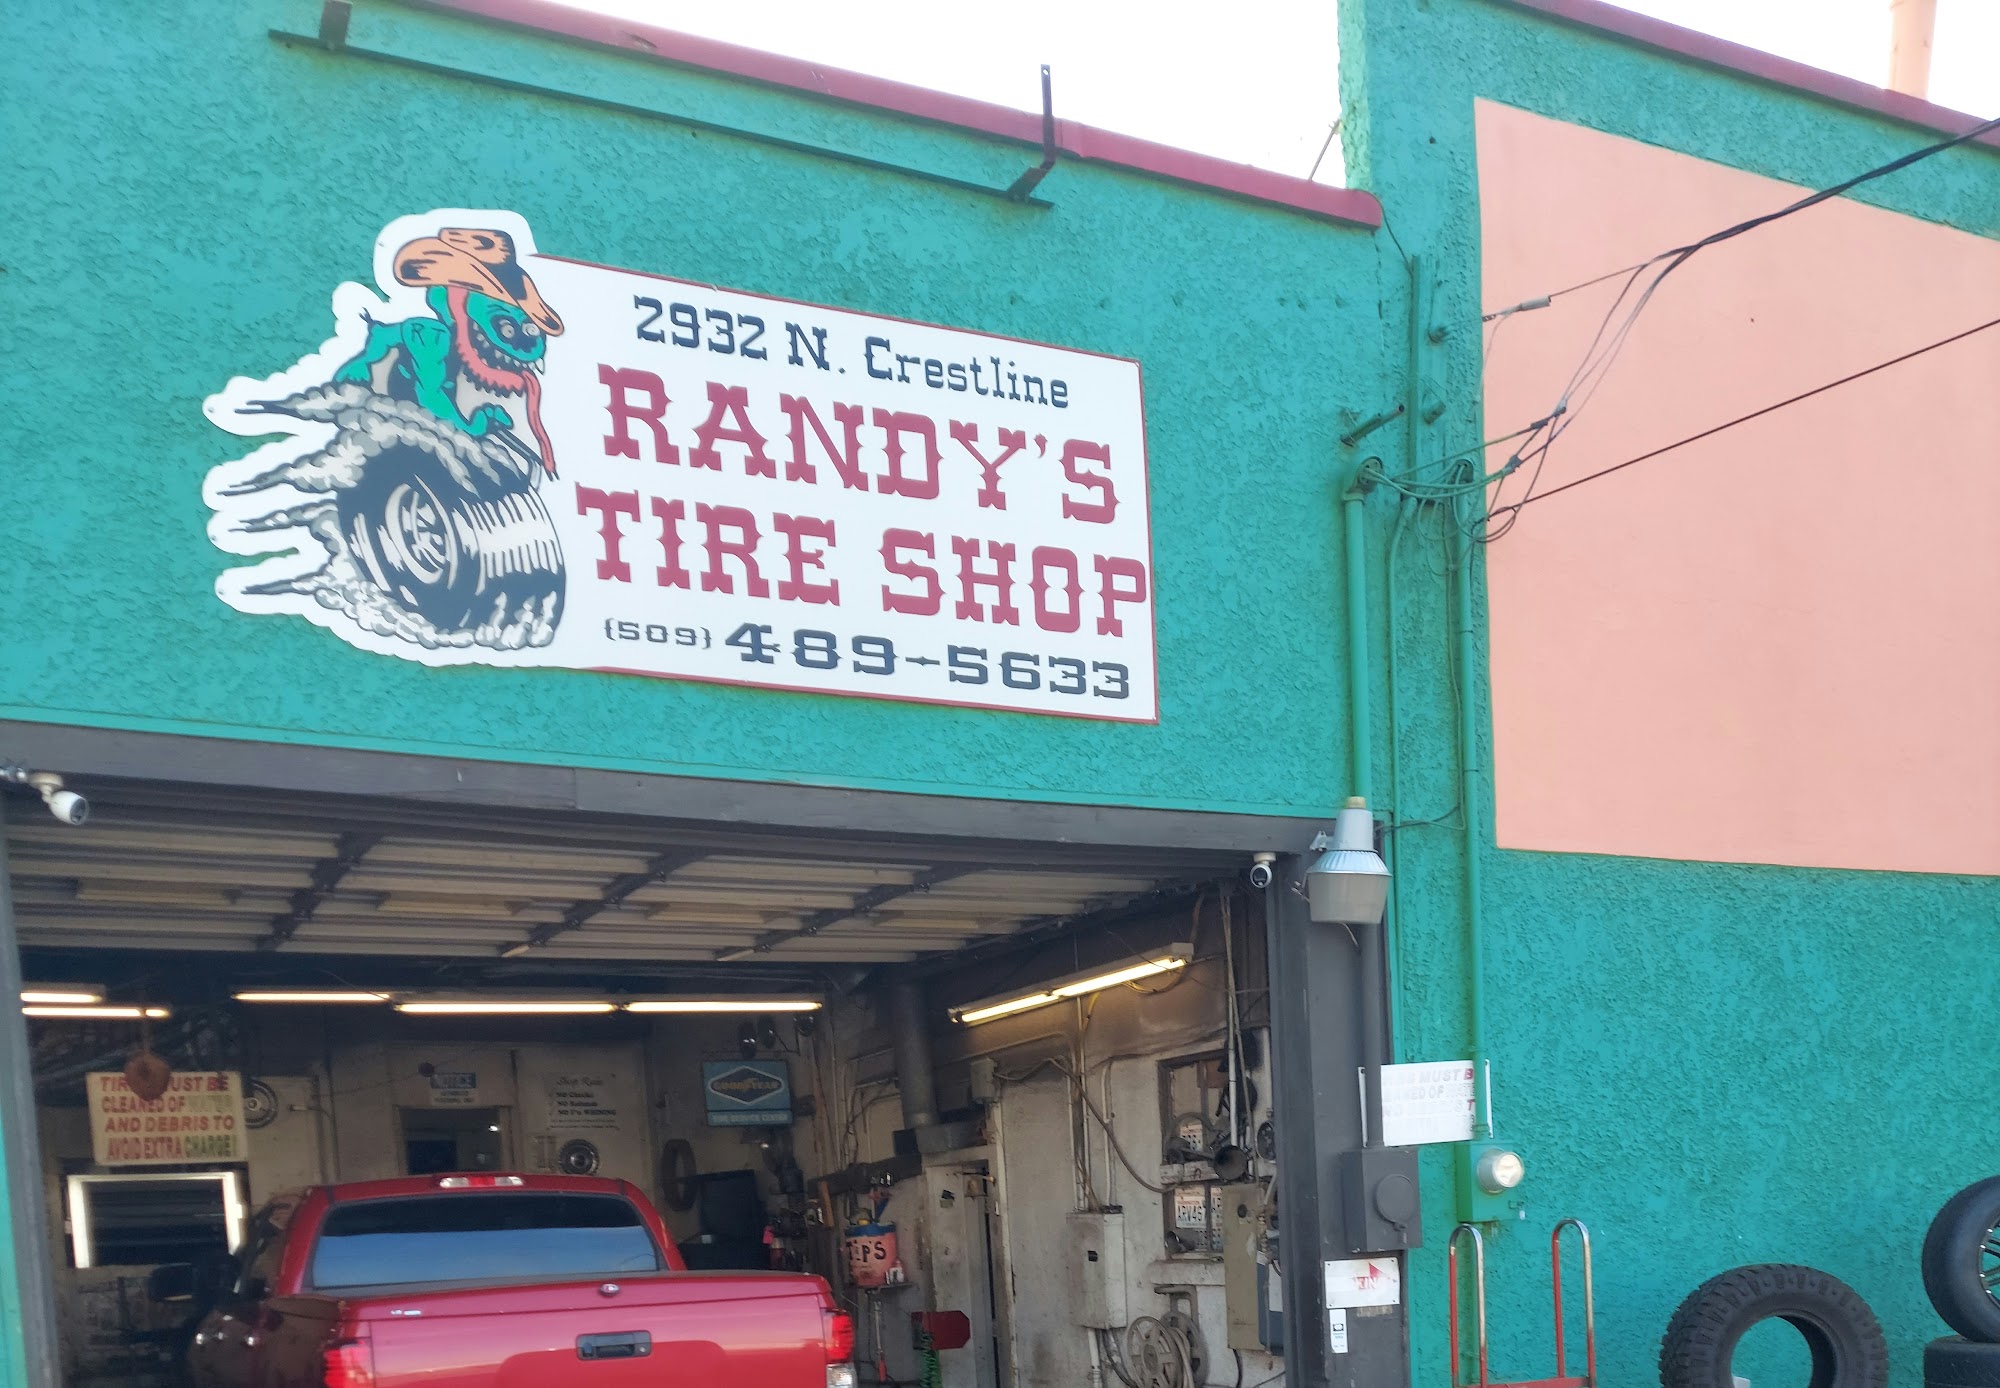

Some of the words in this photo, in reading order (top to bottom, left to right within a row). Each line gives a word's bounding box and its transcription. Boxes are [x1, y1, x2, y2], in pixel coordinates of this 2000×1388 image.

[632, 294, 769, 362] 2932
[784, 321, 847, 375] N.
[862, 335, 1069, 409] Crestline
[597, 362, 1121, 525] RANDY'S
[574, 481, 841, 607] TIRE
[877, 527, 1147, 638] SHOP
[724, 622, 1130, 700] 489-5633
[168, 1096, 185, 1112] OF
[207, 1075, 229, 1092] BE
[105, 1116, 142, 1133] AND
[145, 1115, 209, 1133] DEBRIS
[212, 1114, 235, 1131] TO
[143, 1135, 182, 1160] EXTRA
